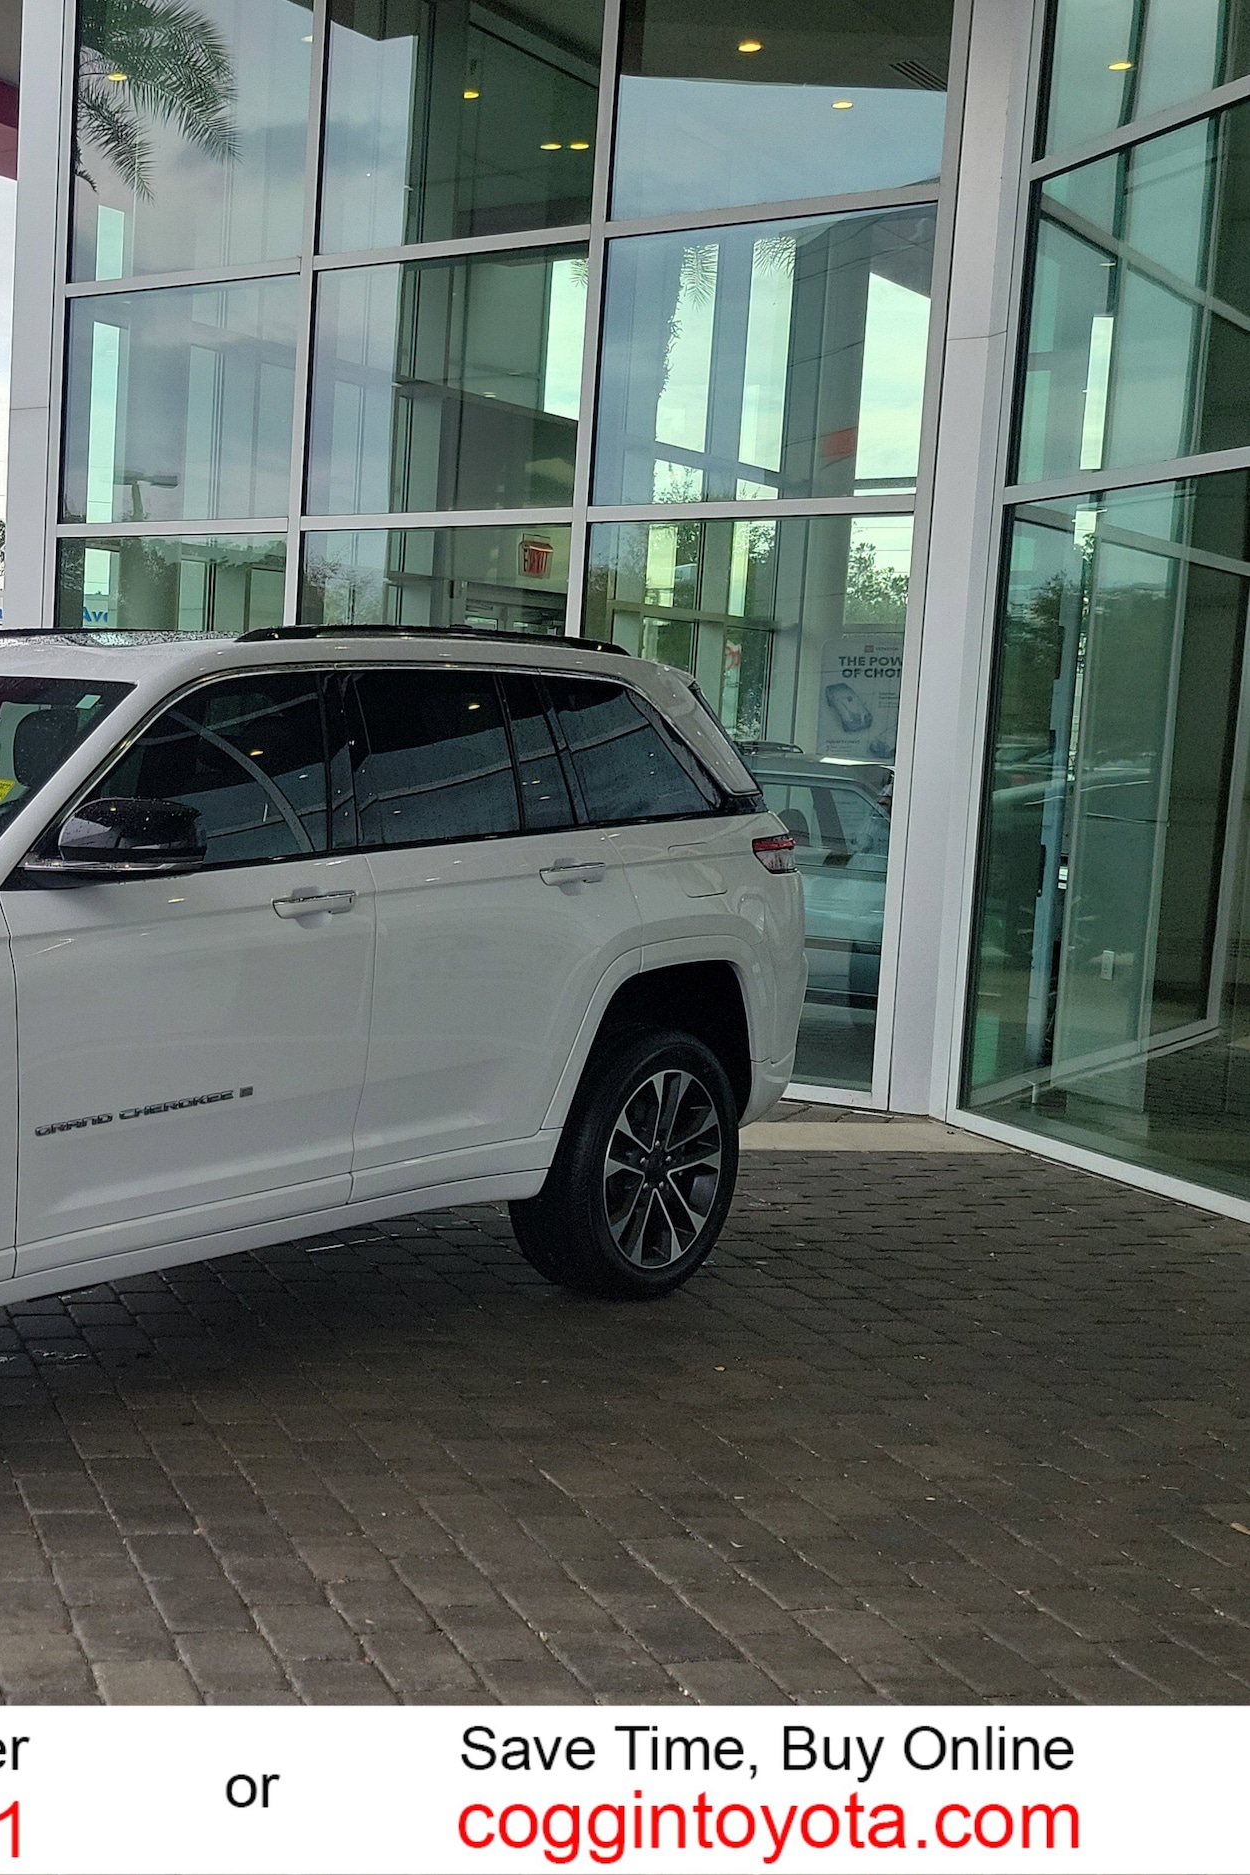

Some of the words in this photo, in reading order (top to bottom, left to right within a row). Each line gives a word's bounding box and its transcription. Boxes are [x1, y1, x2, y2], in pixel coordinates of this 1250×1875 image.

[838, 656, 866, 667] THE
[842, 668, 862, 679] OF
[35, 1113, 113, 1137] GRAND
[119, 1090, 234, 1120] CHEROKEE
